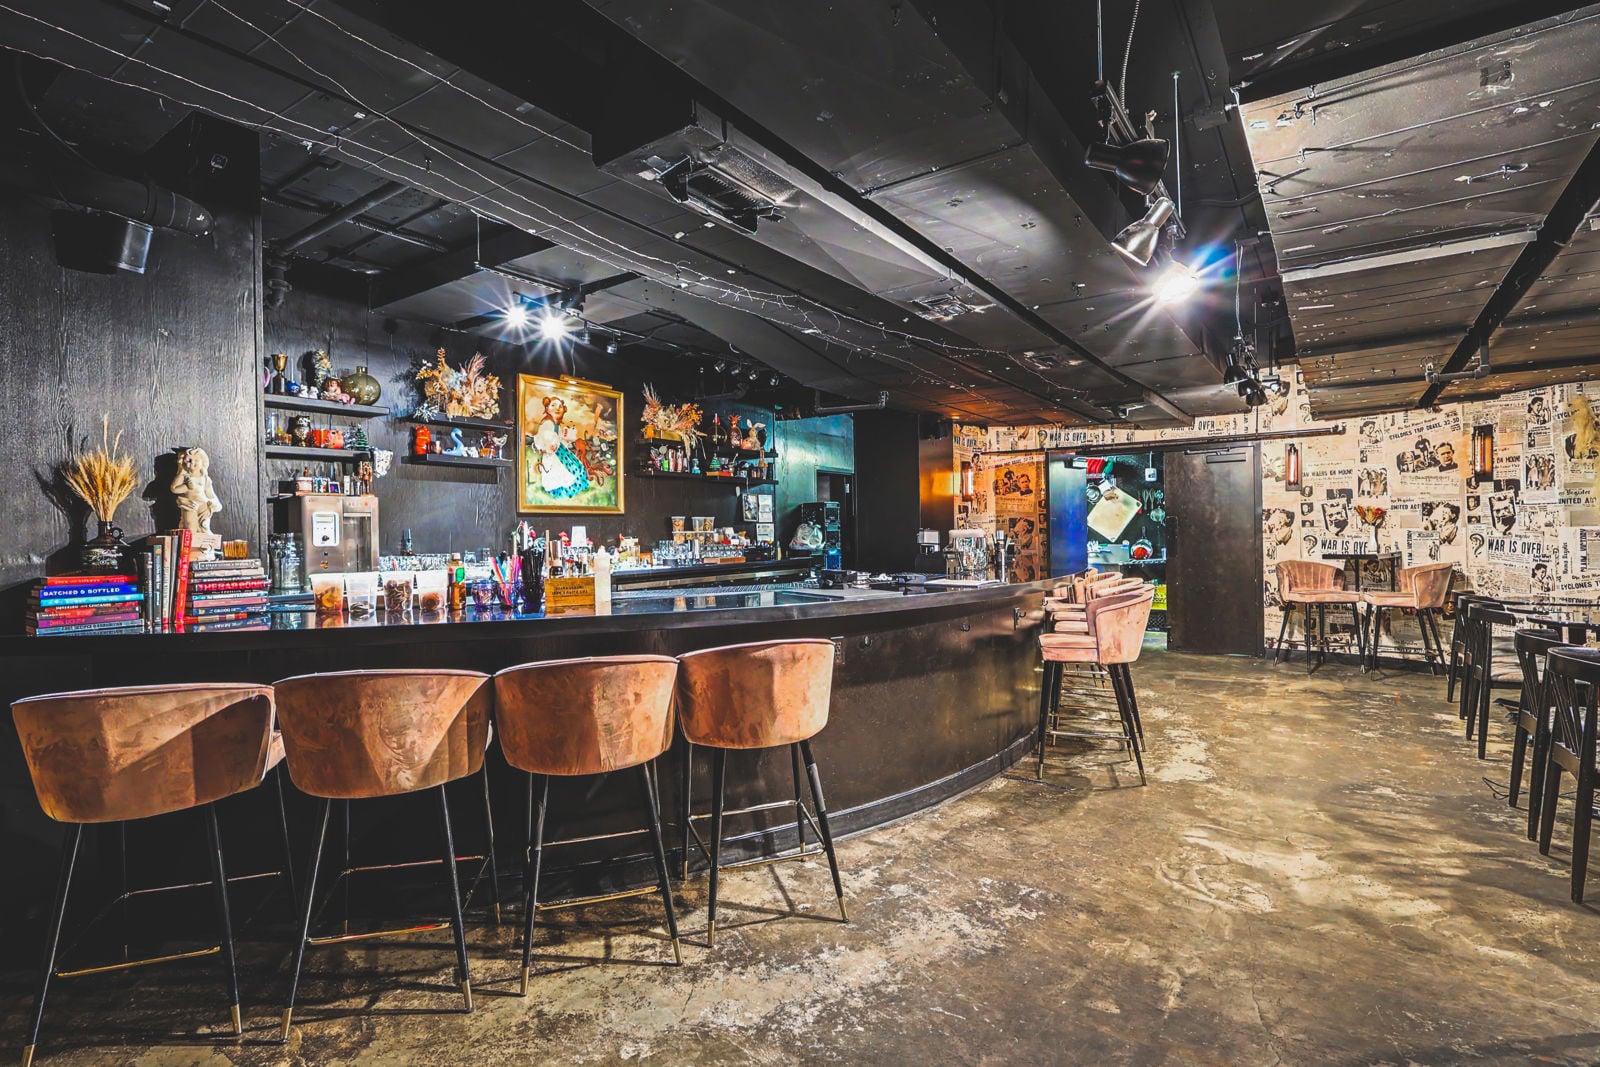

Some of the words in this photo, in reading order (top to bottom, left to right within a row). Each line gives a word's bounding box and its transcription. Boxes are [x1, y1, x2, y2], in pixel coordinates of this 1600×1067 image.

[1321, 538, 1338, 550] WAR
[1341, 540, 1350, 551] IS
[1488, 538, 1505, 552] WAR
[1509, 540, 1518, 553] IS
[1521, 541, 1542, 555] OVER
[1561, 581, 1593, 591] CYCLONES
[43, 589, 79, 597] BATCHED
